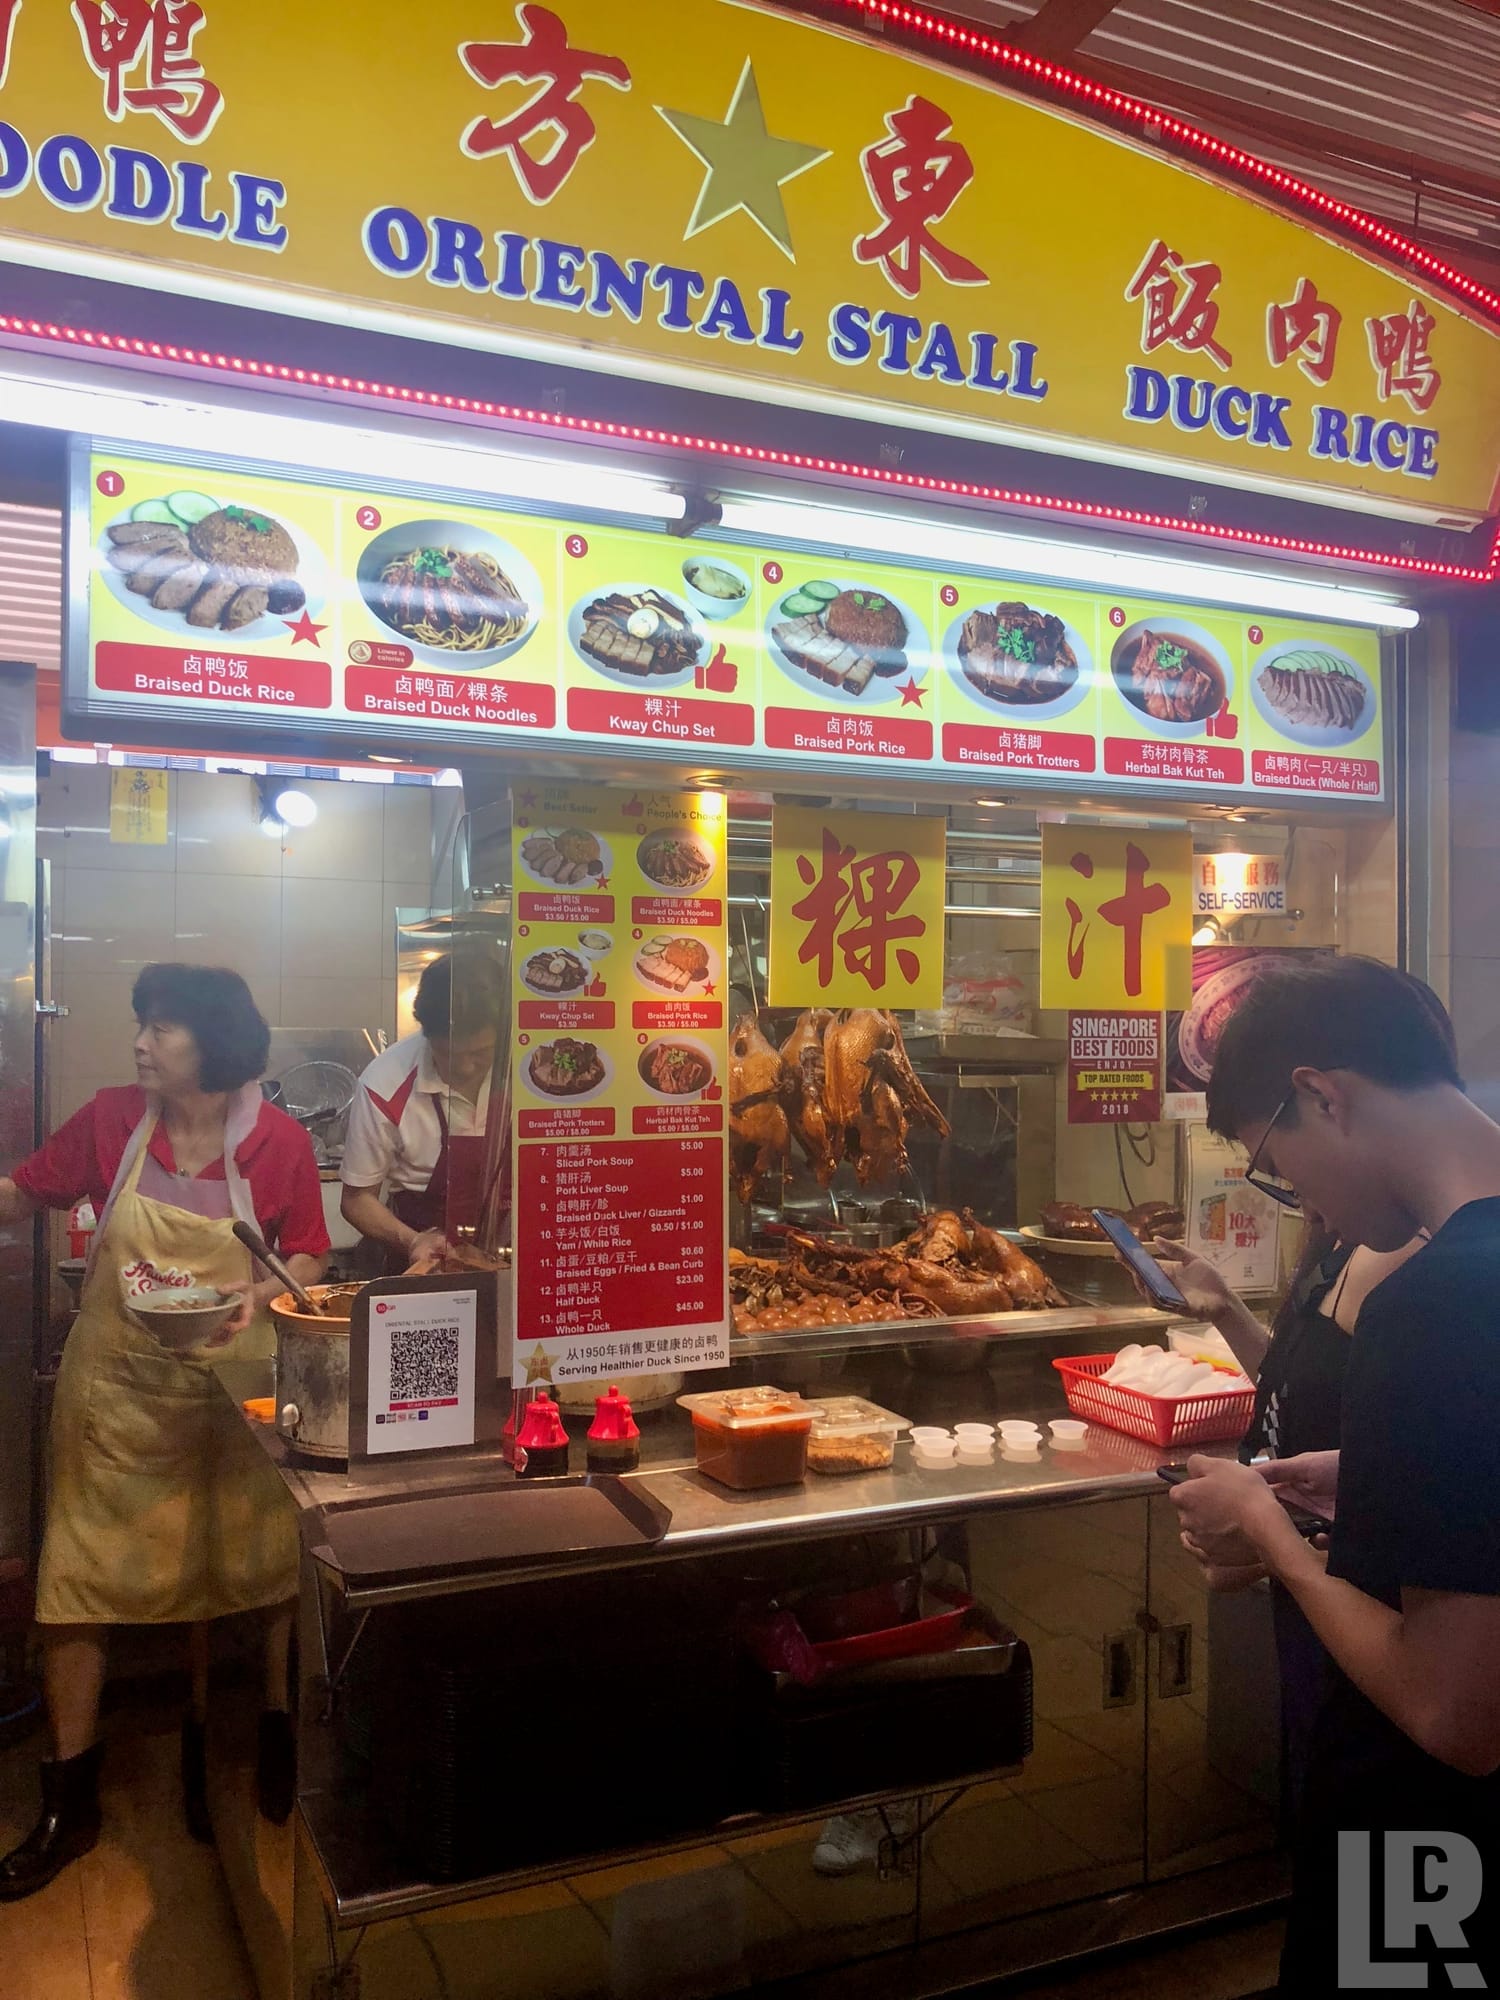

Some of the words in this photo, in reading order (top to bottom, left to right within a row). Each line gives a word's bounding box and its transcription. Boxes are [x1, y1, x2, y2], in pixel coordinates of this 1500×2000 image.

[457, 2, 632, 206] 方
[853, 94, 990, 297] 東
[362, 207, 803, 354] ORIENTAL
[829, 304, 1048, 402] STALL
[1125, 365, 1293, 450] DUCK
[1310, 405, 1440, 480] RICE
[183, 655, 249, 680] 卤鸭饭
[134, 673, 203, 693] Braised
[208, 682, 253, 698] Duck
[258, 686, 295, 702] Rice
[395, 675, 508, 703] 卤鸭面/粿条
[364, 695, 426, 713] Braised
[431, 701, 471, 717] Duck
[475, 705, 538, 724] Noodles
[645, 698, 682, 718] 粿汁
[609, 715, 648, 733] Kway
[652, 719, 689, 736] Chup
[693, 723, 715, 737] Set
[826, 718, 874, 737] 卤肉饭
[794, 734, 842, 749] Braised
[845, 739, 876, 752] Pork
[879, 741, 905, 754] Rice
[999, 732, 1042, 750] 卤猪脚
[959, 748, 1004, 762] Braised
[1007, 752, 1035, 765] Pork
[1036, 754, 1080, 769] Trotters
[1141, 744, 1208, 764] 药材肉骨茶
[1125, 761, 1160, 775] Herbal
[1162, 765, 1183, 777] Bak
[1186, 766, 1204, 778] Kut
[1206, 767, 1225, 780] Teh
[1254, 772, 1291, 785] Braised
[1293, 774, 1317, 788] Duck
[1319, 777, 1349, 790] (Whole
[1357, 780, 1378, 794] Half)
[1199, 892, 1283, 910] SELF-SERVICE
[534, 904, 562, 913] Braised
[640, 908, 666, 916] Braised
[668, 909, 685, 917] Duck
[792, 827, 926, 991] 粿
[1065, 841, 1171, 996] 汁
[540, 1012, 560, 1020] Kway
[562, 1012, 581, 1020] Chup
[1072, 1018, 1157, 1037] SINGAPORE
[1073, 1040, 1107, 1056] BEST
[1112, 1040, 1154, 1056] FOODS
[1097, 1060, 1132, 1069] ENJOY
[1085, 1074, 1098, 1083] TOP
[1100, 1074, 1120, 1083] RATED
[1122, 1074, 1144, 1083] FOODS
[529, 1119, 557, 1128] Braised
[559, 1119, 576, 1127] Pork
[541, 1148, 549, 1156] 7.
[681, 1141, 703, 1150] $5.00
[556, 1159, 584, 1168] Sliced
[587, 1158, 608, 1167] Pork
[610, 1157, 633, 1167] Soup
[556, 1172, 592, 1184] 猪肝汤
[681, 1168, 703, 1177] $5.00
[541, 1175, 549, 1184] 8.
[556, 1187, 577, 1195] Pork
[580, 1186, 602, 1194] Liver
[605, 1184, 628, 1194] Soup
[681, 1194, 703, 1204] $1.00
[541, 1203, 549, 1212] 9.
[556, 1213, 591, 1223] Braised
[593, 1212, 617, 1221] Duck
[619, 1211, 641, 1219] Liver
[649, 1208, 686, 1218] Gizzards
[651, 1223, 674, 1232] $0.50
[681, 1221, 703, 1230] $1.00
[540, 1230, 553, 1240] 10.
[556, 1242, 576, 1251] Yam
[584, 1239, 609, 1249] White
[611, 1238, 631, 1247] Rice
[681, 1247, 703, 1256] $0.60
[540, 1259, 553, 1268] 11.
[556, 1268, 591, 1279] Braised
[594, 1266, 616, 1277] Eggs
[624, 1264, 647, 1273] Fried
[649, 1263, 656, 1271] &
[658, 1262, 680, 1271] Bean
[682, 1260, 703, 1269] Curb
[676, 1274, 704, 1285] $23.00
[540, 1286, 553, 1295] 12.
[556, 1298, 575, 1307] Half
[577, 1295, 600, 1305] Duck
[676, 1301, 704, 1312] $45.00
[540, 1315, 553, 1324] 13.
[556, 1325, 585, 1335] Whole
[587, 1322, 610, 1332] Duck
[559, 1364, 598, 1376] Serving
[600, 1361, 644, 1372] Healthier
[647, 1357, 672, 1367] Duck
[674, 1354, 701, 1364] Since
[703, 1351, 725, 1361] 1950
